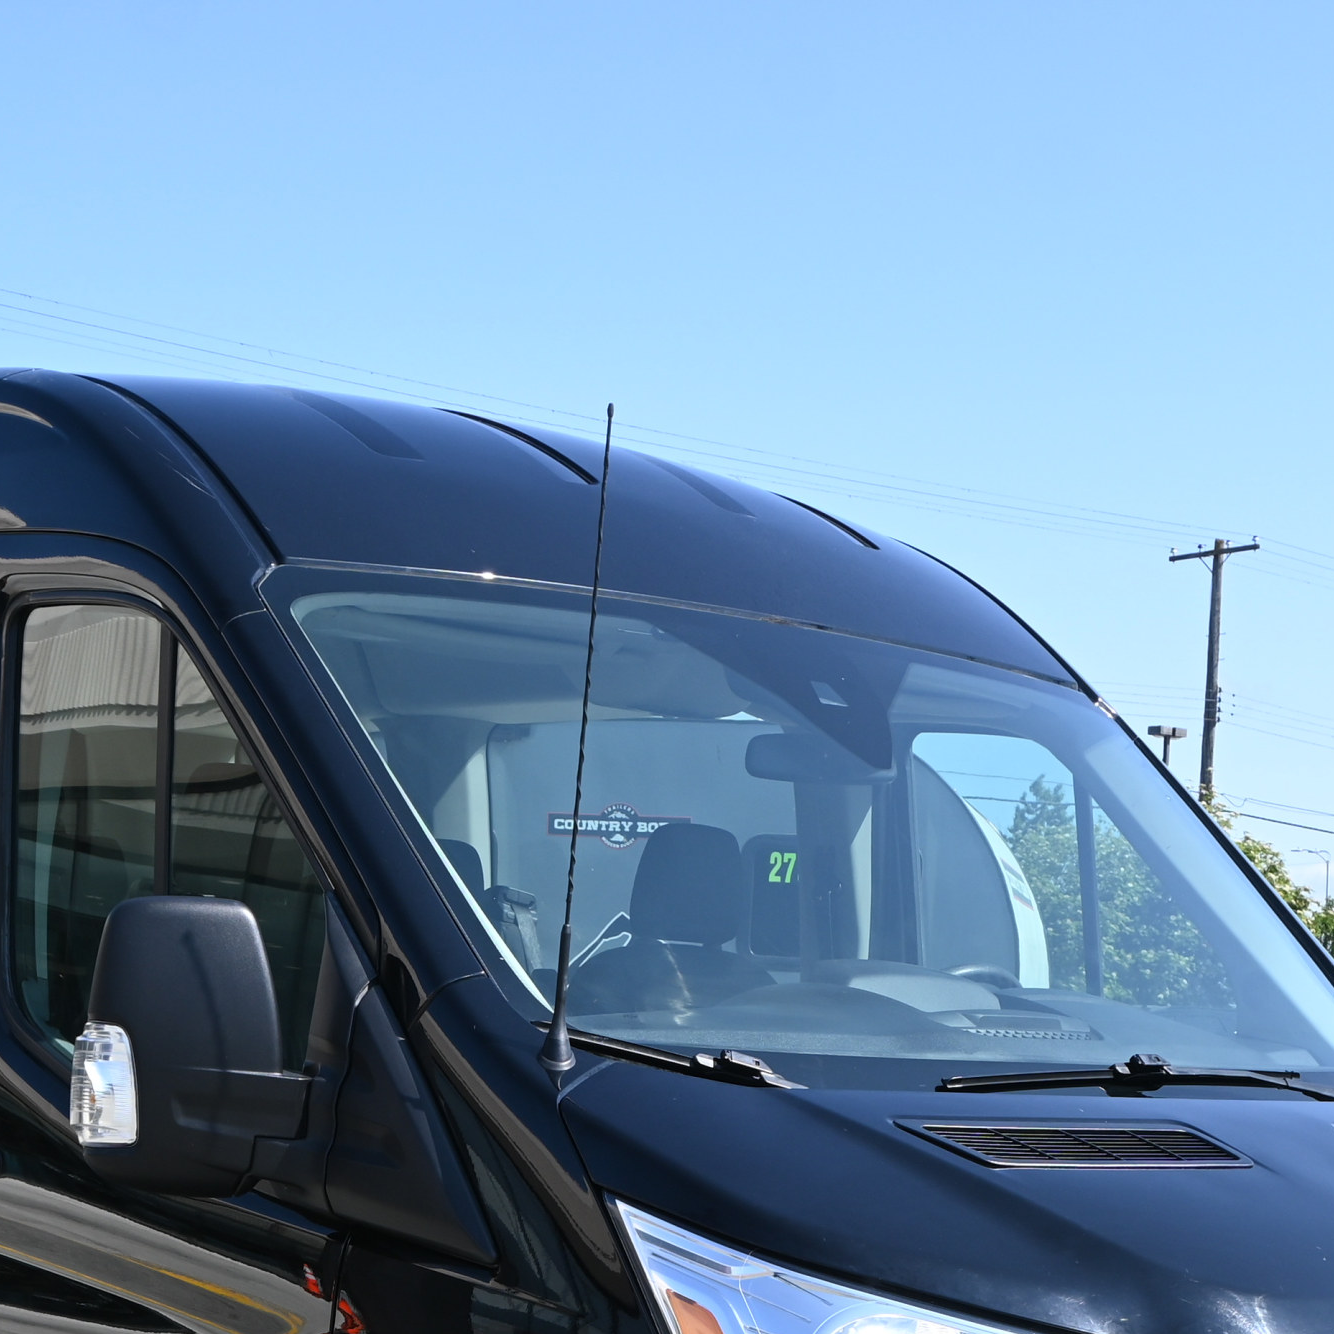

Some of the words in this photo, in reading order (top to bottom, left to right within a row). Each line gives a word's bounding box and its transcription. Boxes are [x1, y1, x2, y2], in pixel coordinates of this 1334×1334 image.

[553, 818, 633, 832] COUNTRY
[636, 821, 669, 833] BO
[768, 851, 798, 883] 27
